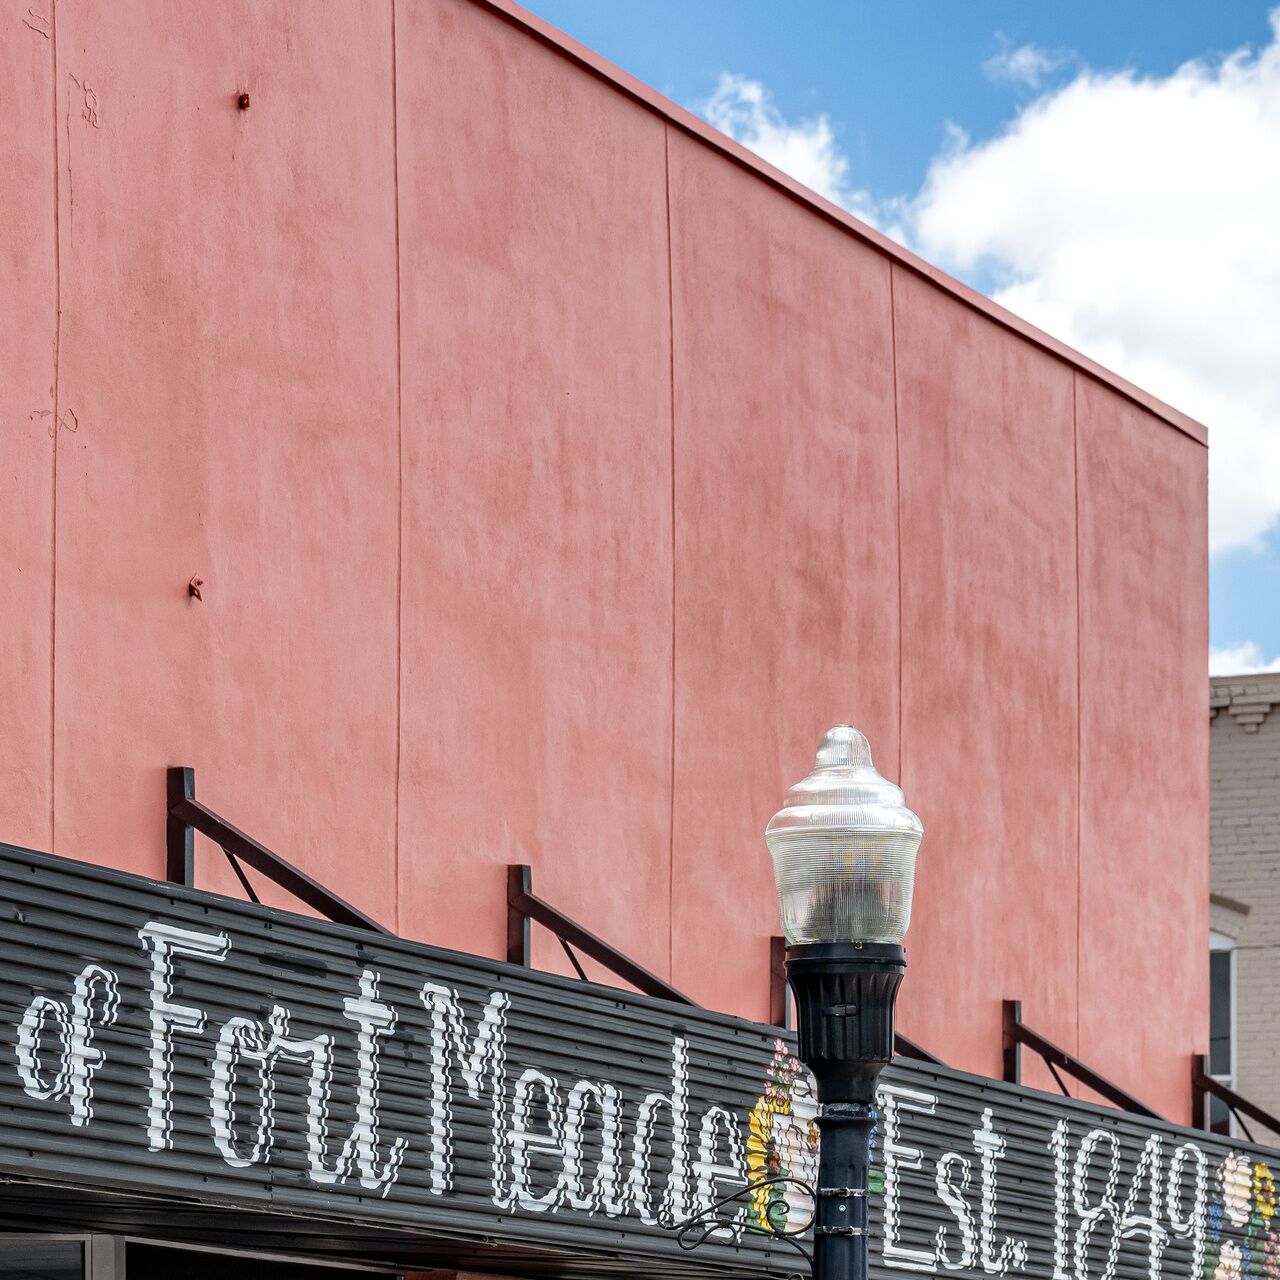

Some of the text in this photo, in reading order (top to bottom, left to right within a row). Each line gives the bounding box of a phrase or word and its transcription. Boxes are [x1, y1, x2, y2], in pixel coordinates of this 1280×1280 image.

[17, 964, 120, 1127] of
[138, 921, 409, 1198] Fort
[421, 982, 751, 1243] Meade
[876, 1083, 1030, 1277] Est.
